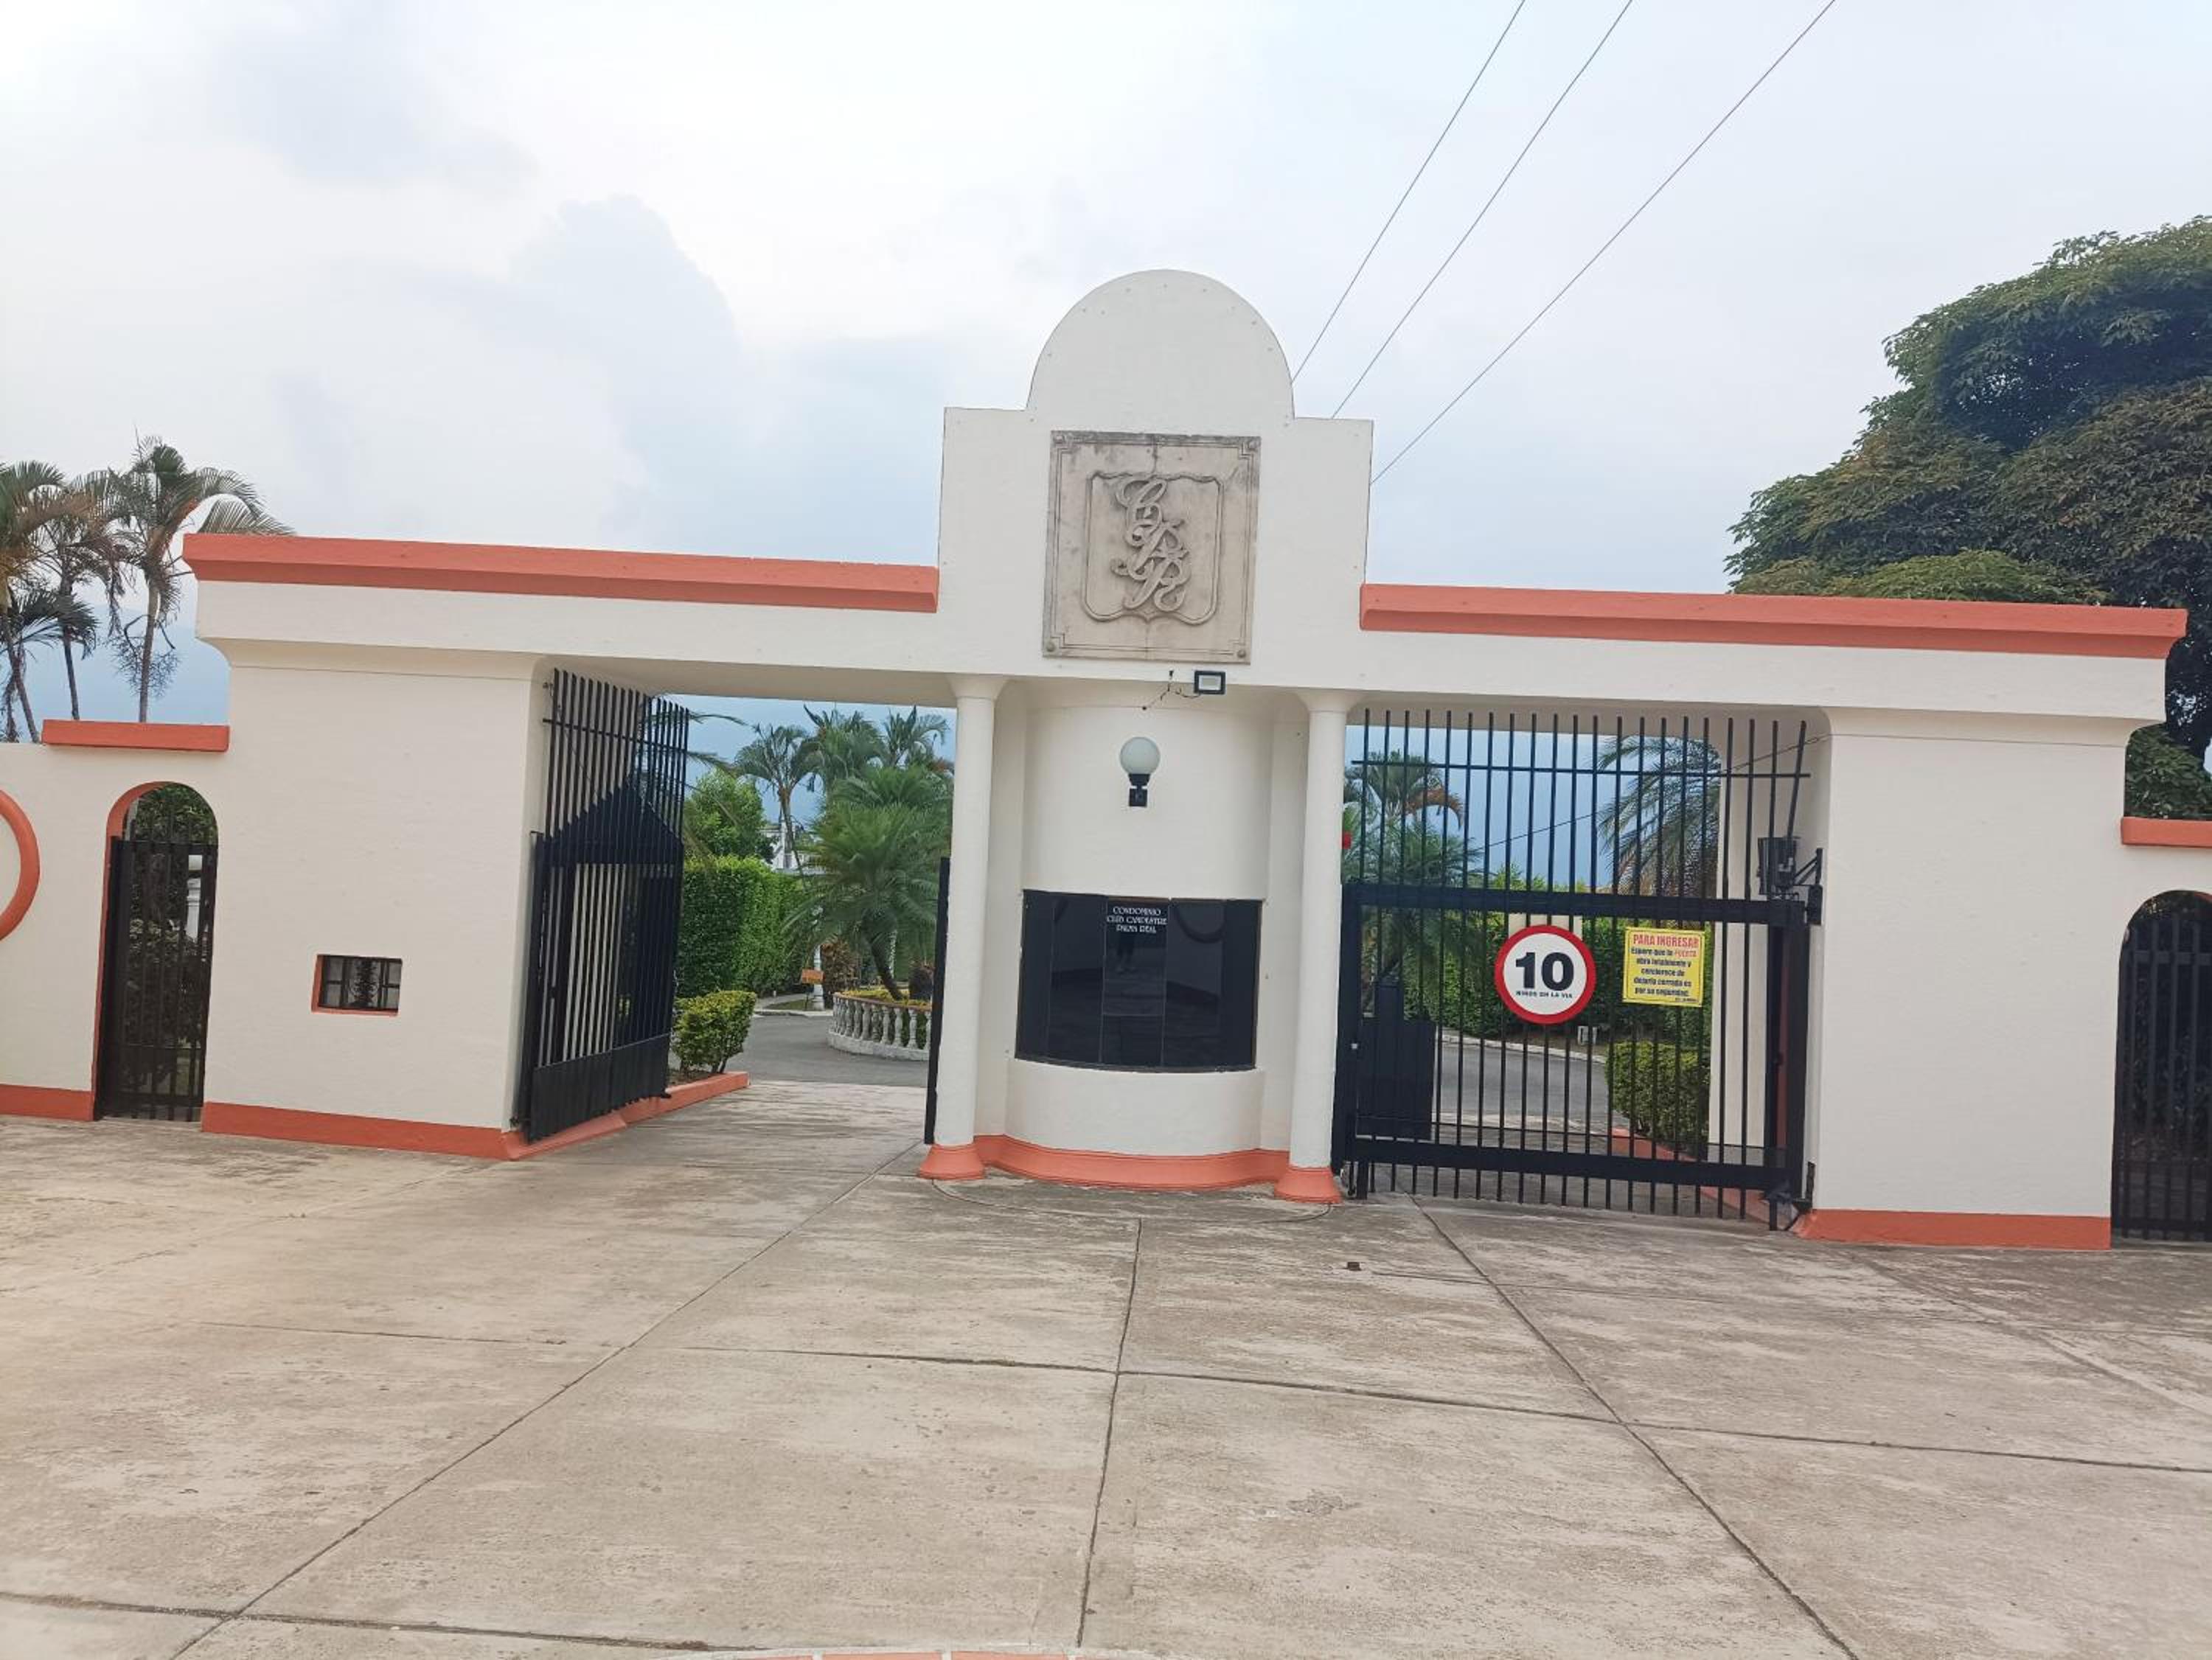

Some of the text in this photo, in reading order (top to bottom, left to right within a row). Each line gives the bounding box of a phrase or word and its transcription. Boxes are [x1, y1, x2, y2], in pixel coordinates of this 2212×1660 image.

[1113, 906, 1161, 916] CONDOMINIO
[1633, 934, 1700, 948] PARA INGRESAR
[1515, 952, 1574, 991] 10
